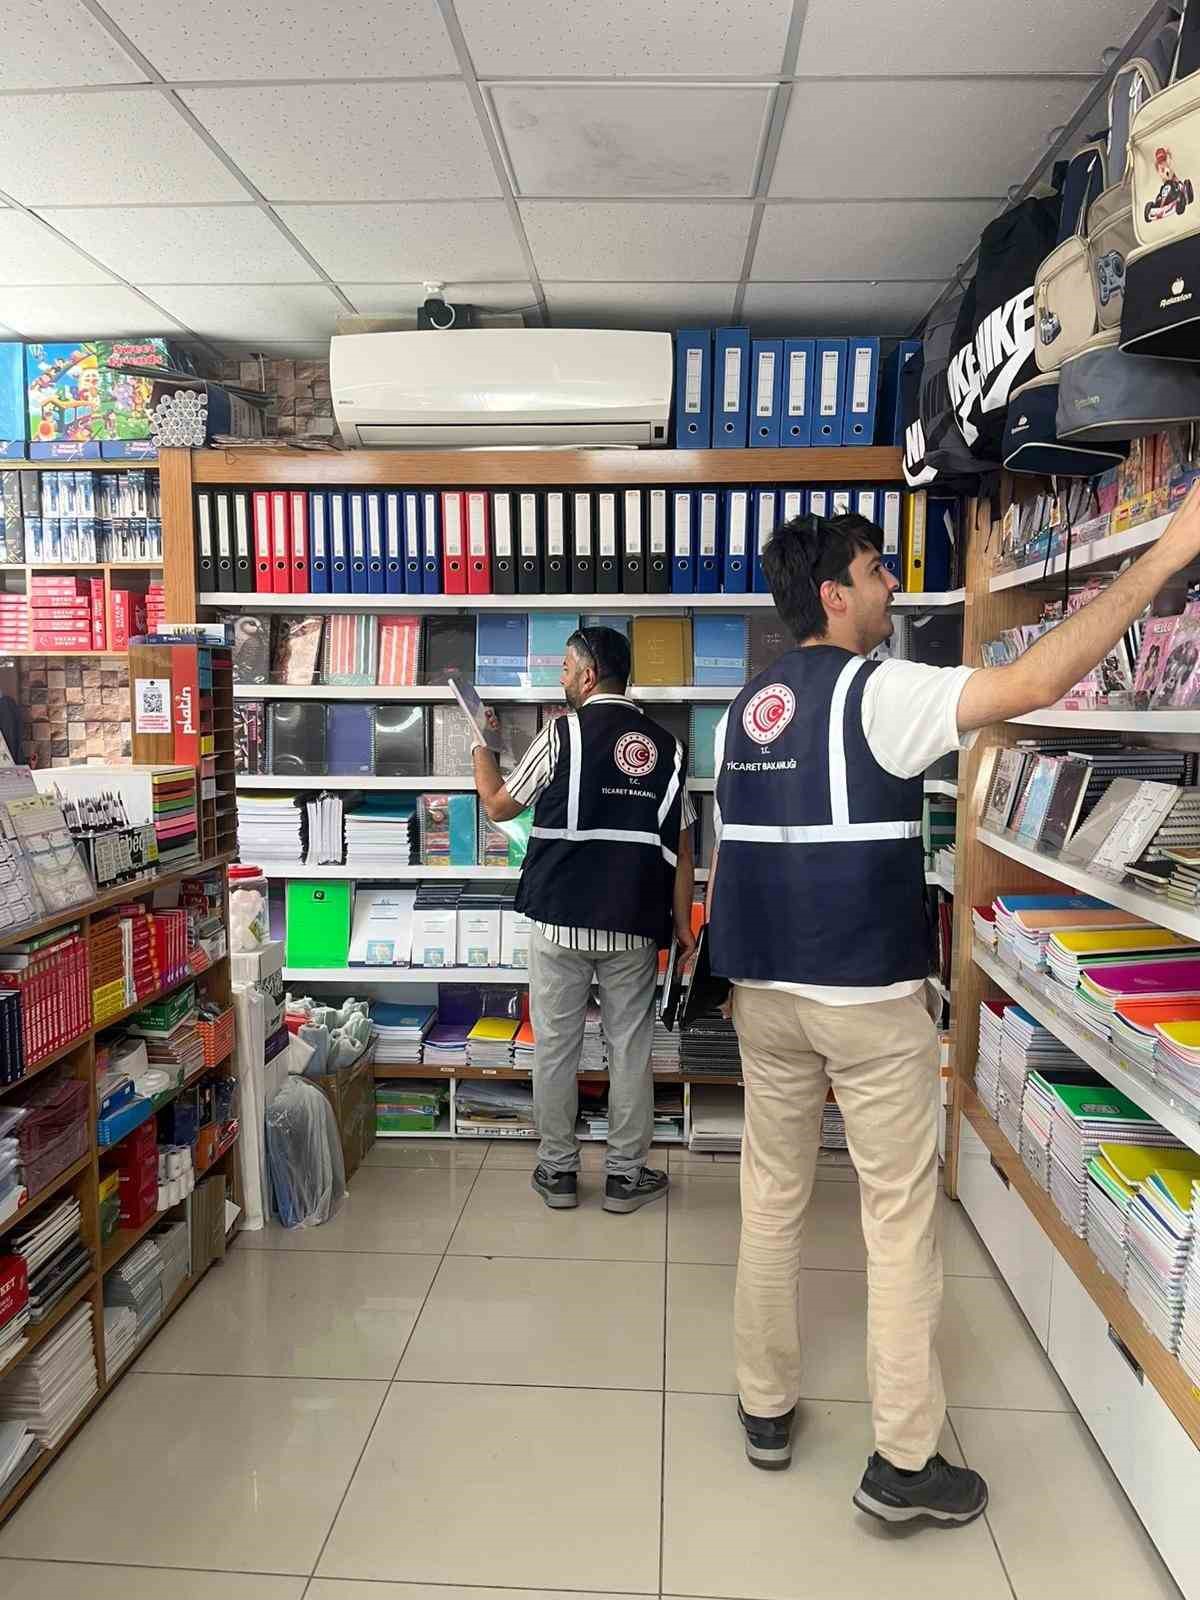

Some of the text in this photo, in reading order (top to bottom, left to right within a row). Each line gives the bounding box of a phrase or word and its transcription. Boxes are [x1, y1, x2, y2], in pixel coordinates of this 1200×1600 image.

[975, 286, 1035, 382] NIKE
[175, 686, 198, 735] platin
[726, 760, 761, 772] TİCARET
[601, 785, 628, 796] TİCARET
